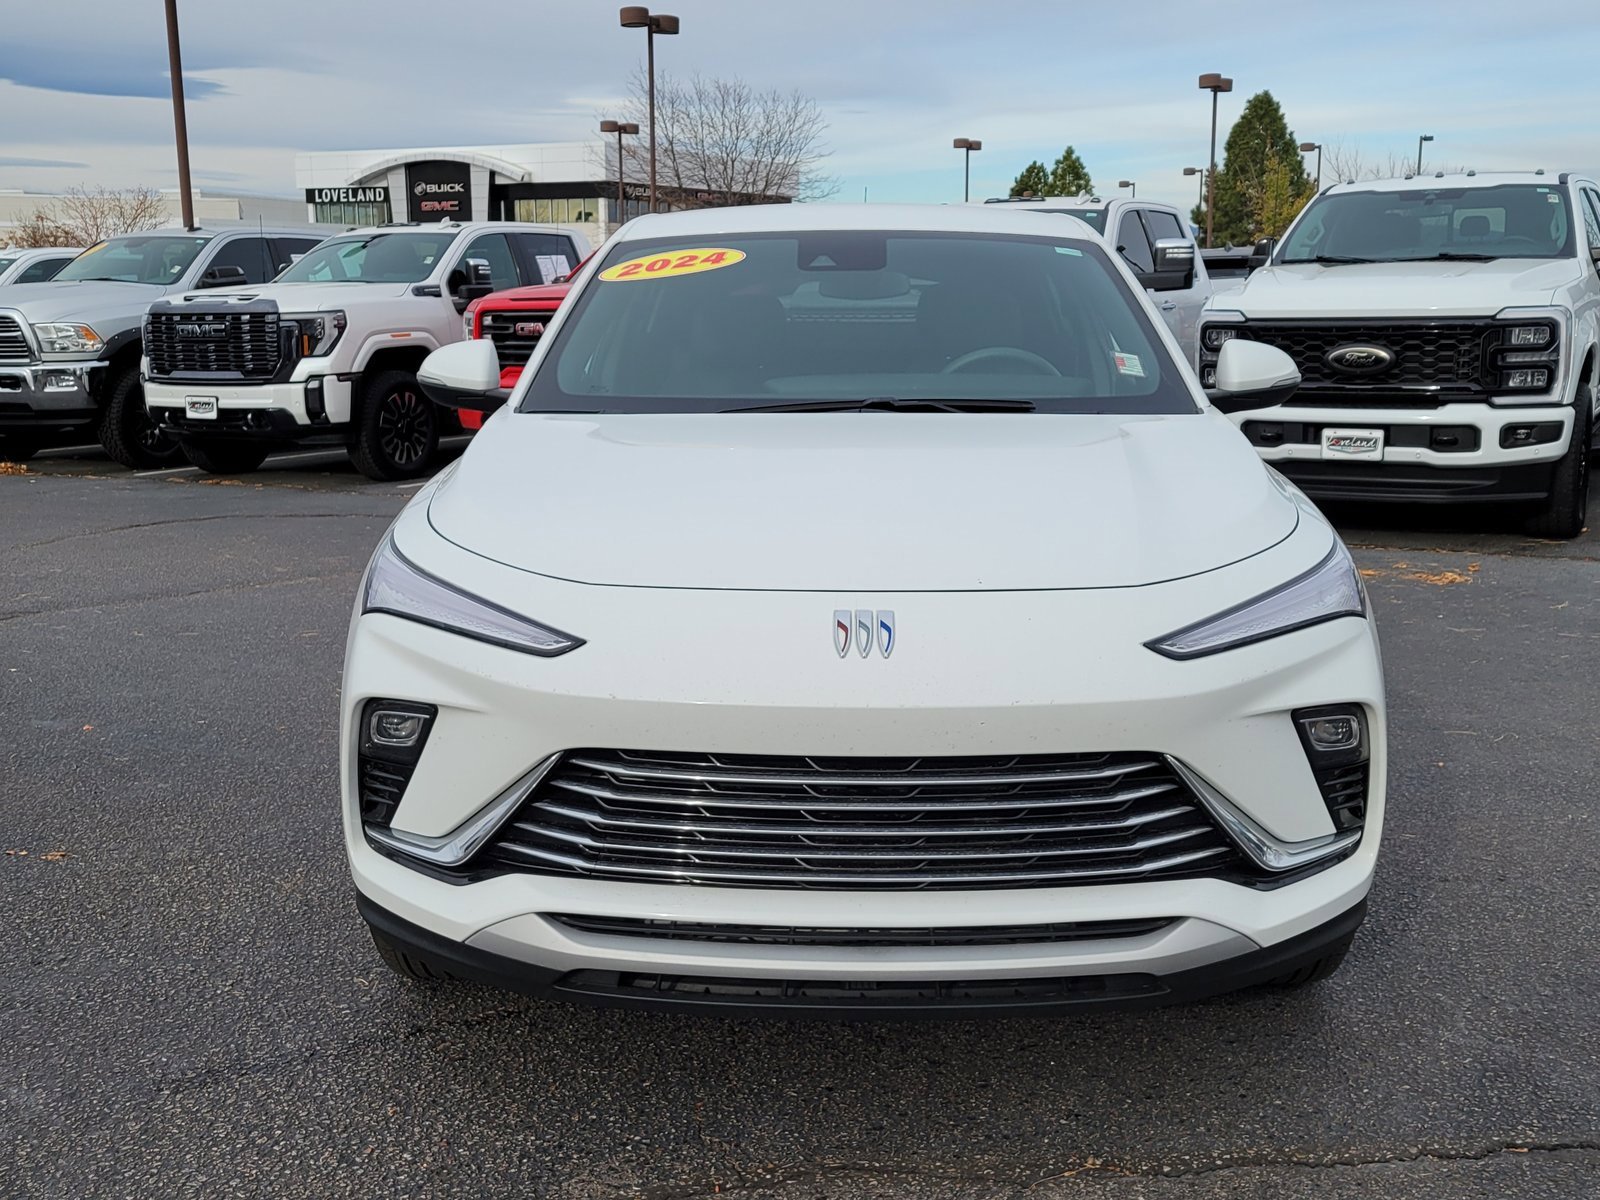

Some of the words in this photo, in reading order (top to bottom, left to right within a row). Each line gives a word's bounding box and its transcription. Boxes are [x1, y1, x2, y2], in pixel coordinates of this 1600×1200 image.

[426, 183, 465, 193] BUICK
[314, 188, 385, 203] LOVELAND
[421, 200, 460, 212] GMC
[615, 251, 728, 278] 2024
[176, 324, 226, 338] GMC
[1342, 352, 1376, 366] Ford
